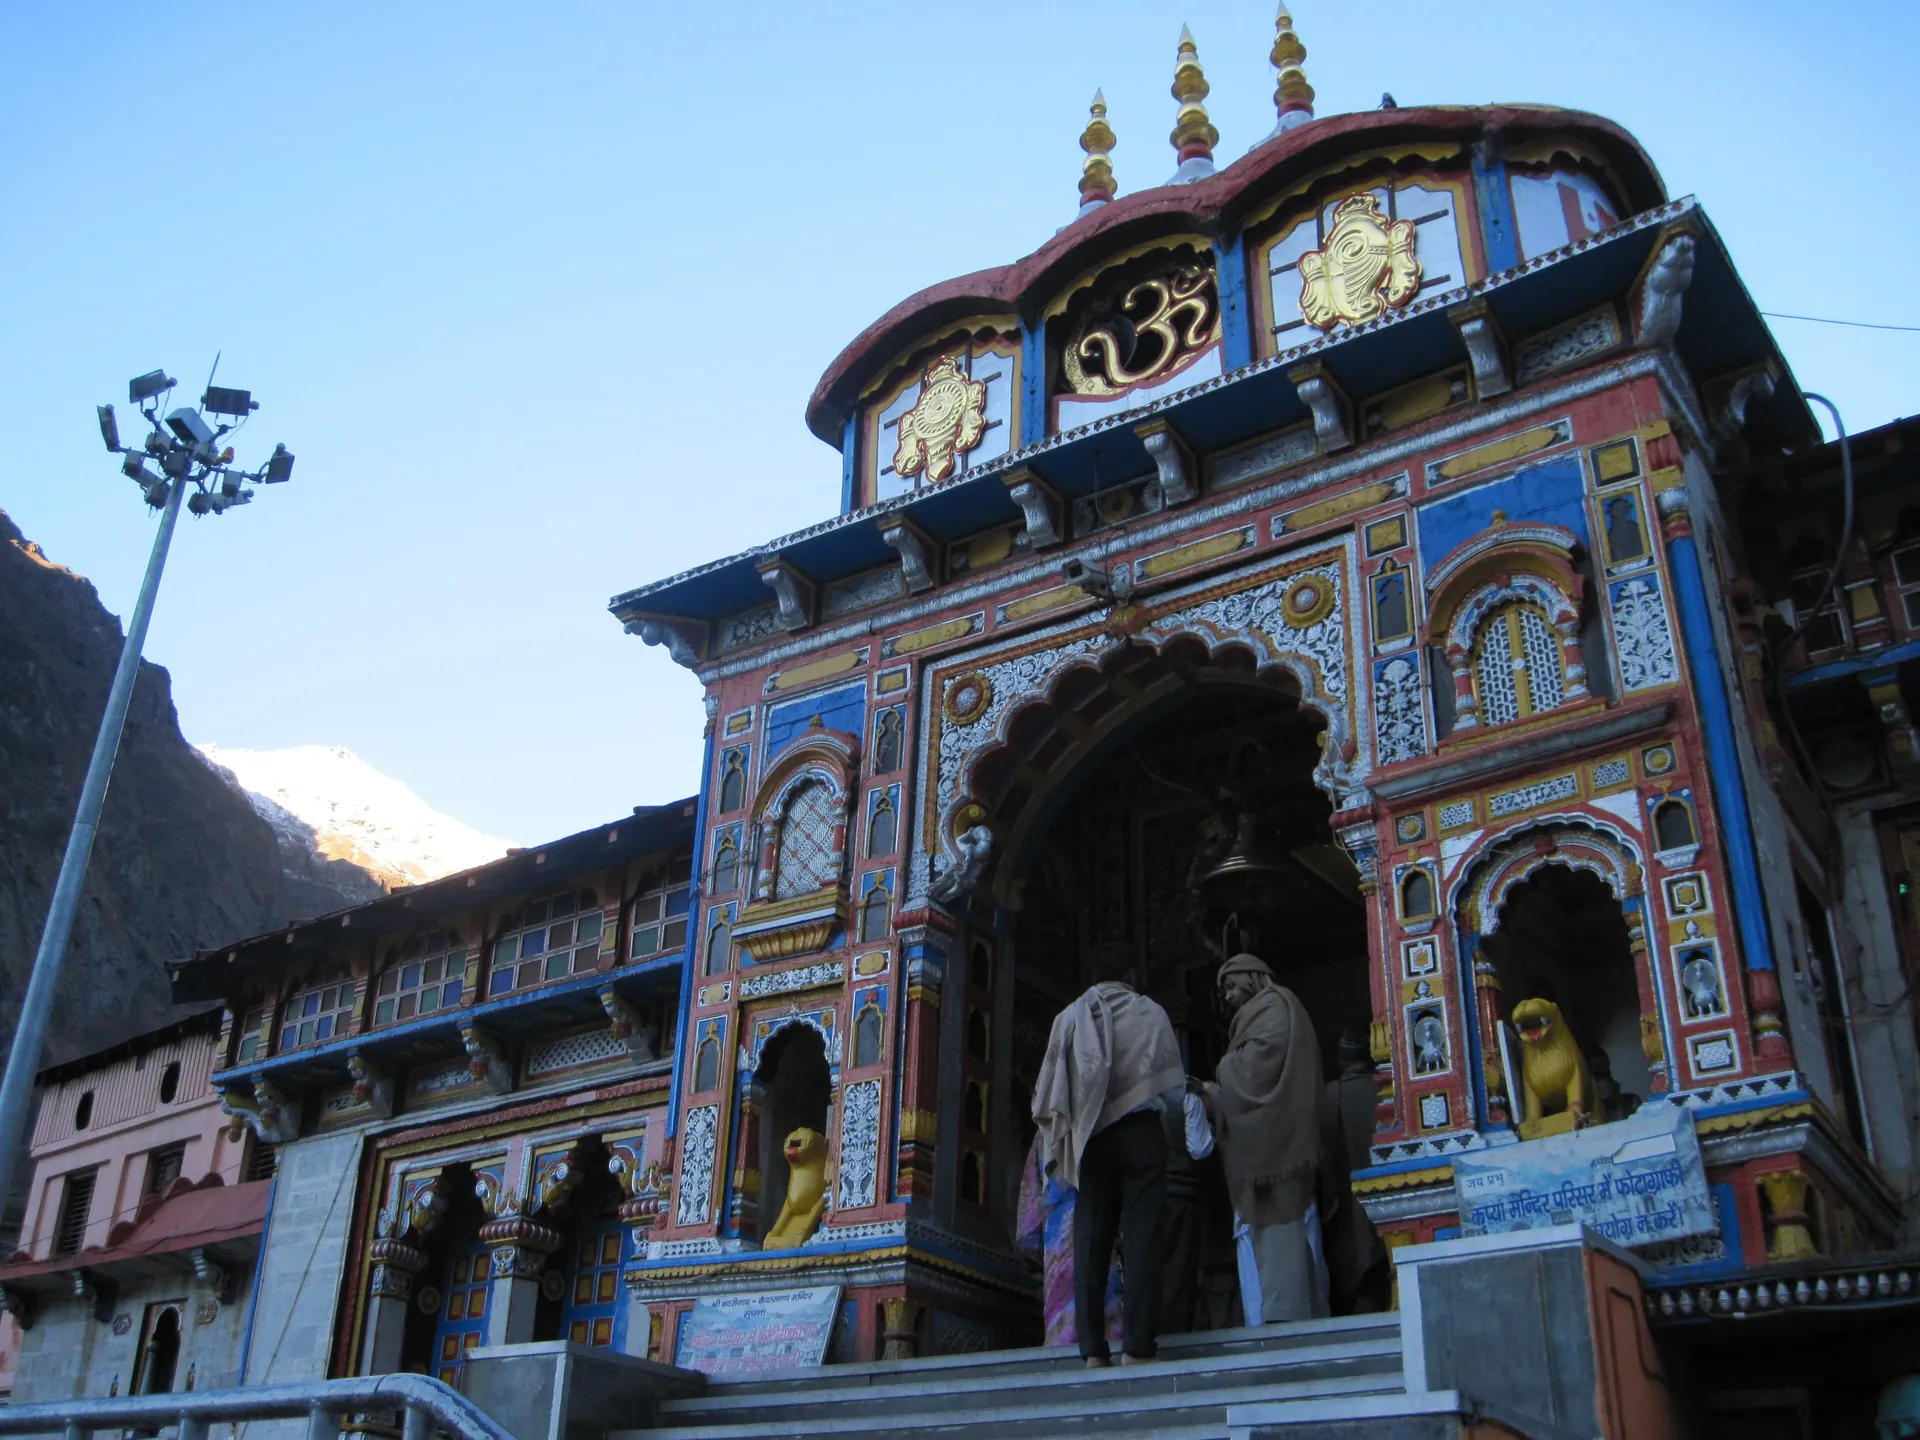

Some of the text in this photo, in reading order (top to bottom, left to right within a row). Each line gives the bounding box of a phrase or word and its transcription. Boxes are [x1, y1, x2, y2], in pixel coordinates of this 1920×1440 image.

[1466, 1173, 1505, 1189] जय प्रभु
[1509, 1189, 1551, 1219] मन्दिर
[1552, 1180, 1596, 1210] परिसर
[1596, 1172, 1612, 1201] में
[1635, 1214, 1649, 1233] न
